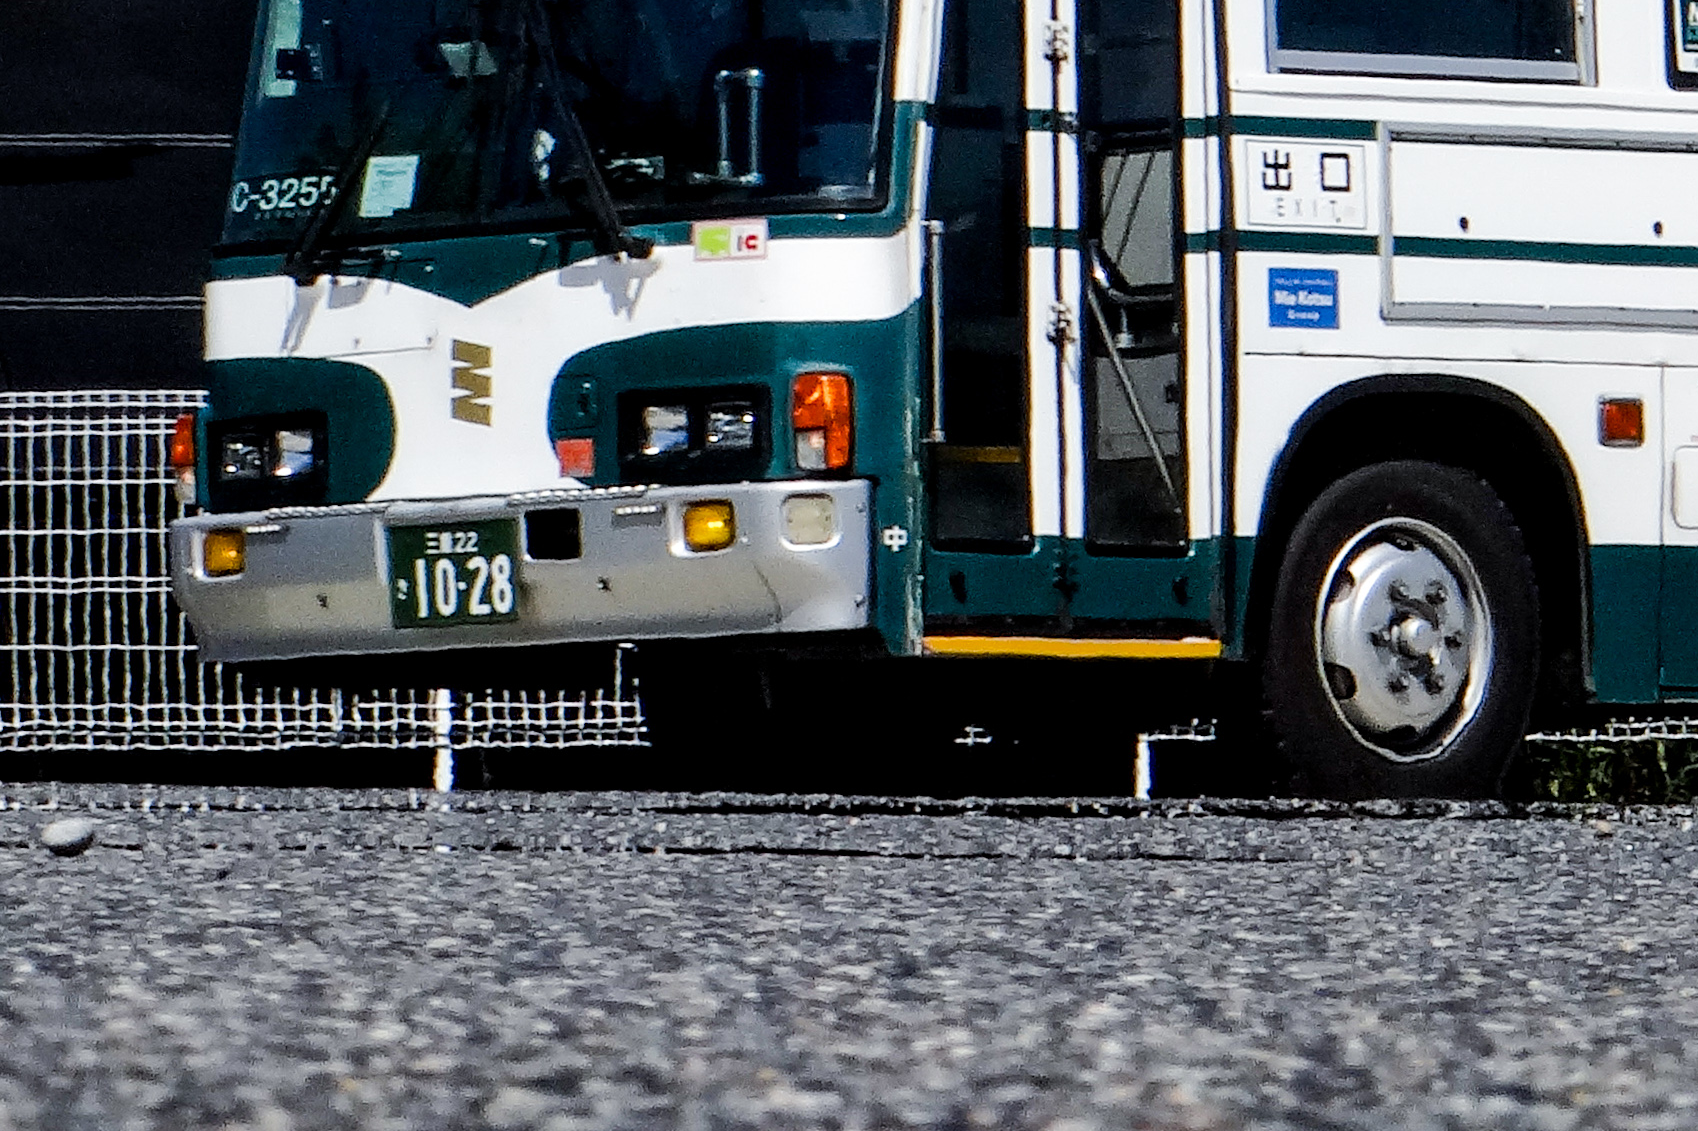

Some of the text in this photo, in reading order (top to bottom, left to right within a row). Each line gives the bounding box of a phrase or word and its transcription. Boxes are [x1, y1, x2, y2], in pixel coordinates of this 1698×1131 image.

[1262, 149, 1351, 192] 出口
[231, 175, 339, 213] C-3255
[414, 553, 514, 619] 10-28
